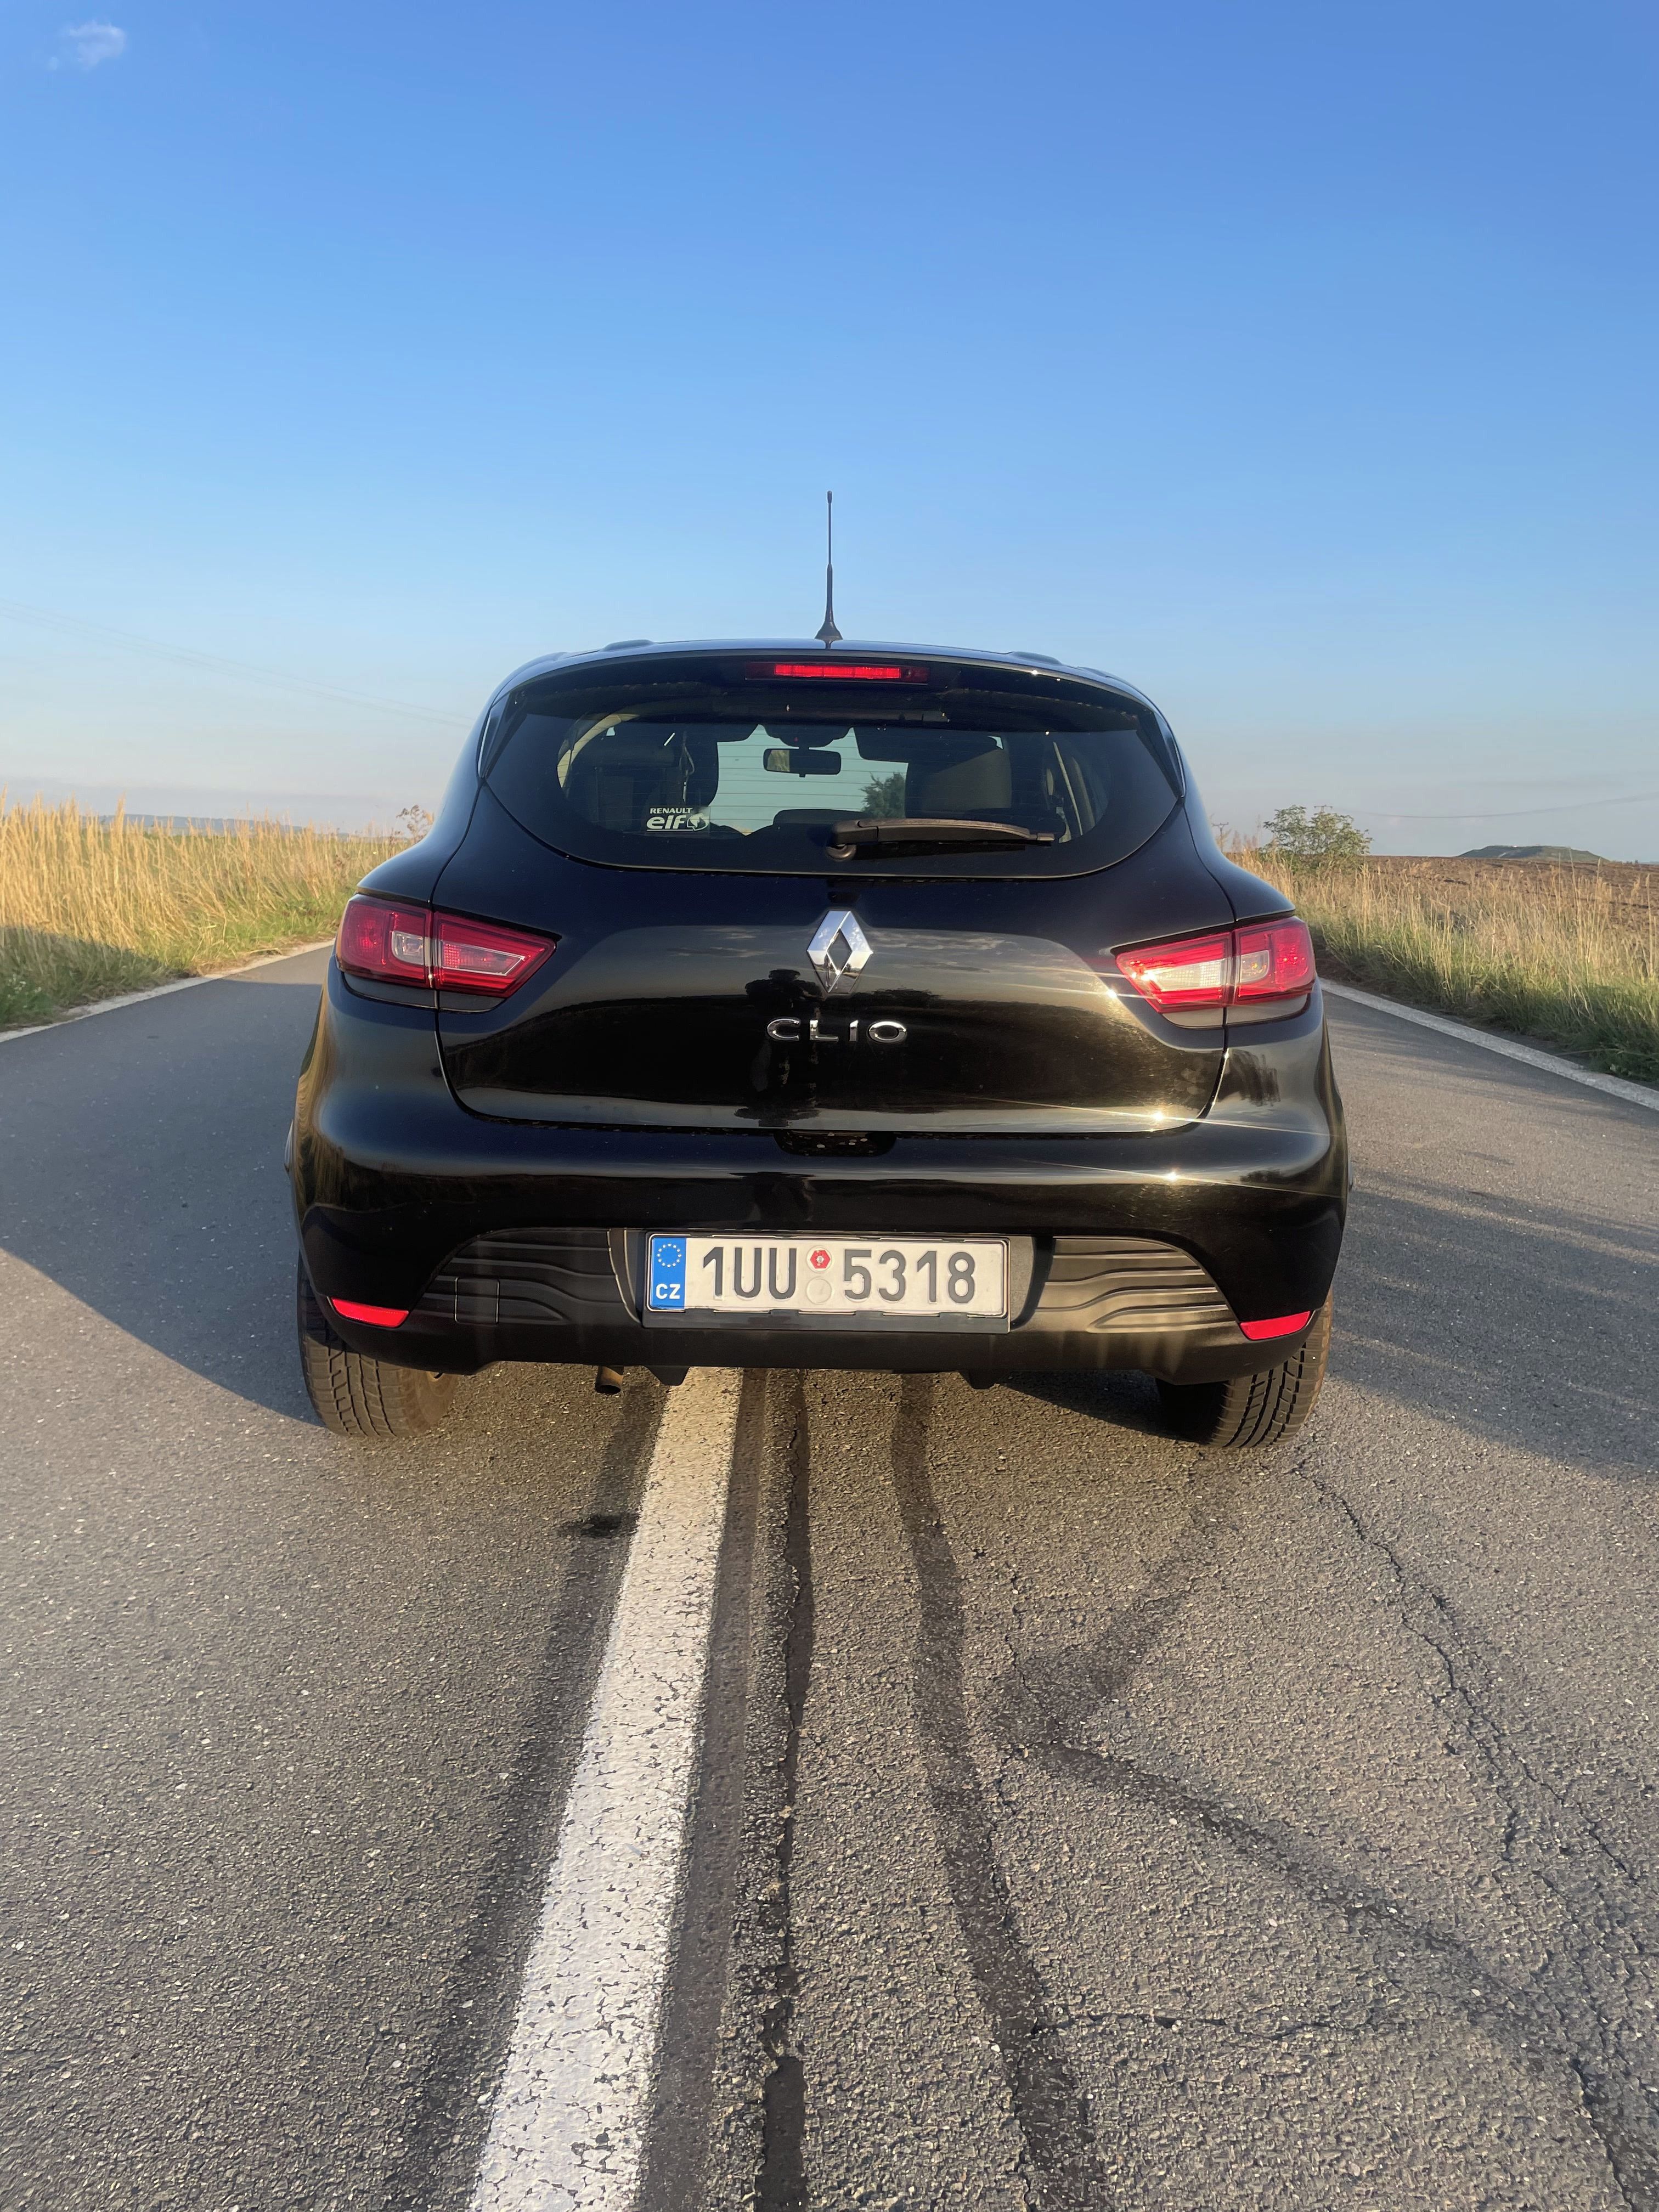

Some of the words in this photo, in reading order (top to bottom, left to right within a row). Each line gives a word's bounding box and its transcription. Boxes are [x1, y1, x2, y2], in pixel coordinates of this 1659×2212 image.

[646, 815, 686, 829] elf
[767, 1018, 907, 1043] CLIO
[703, 1246, 796, 1299] 1UU
[844, 1249, 975, 1304] 5318
[656, 1283, 681, 1300] CZ
